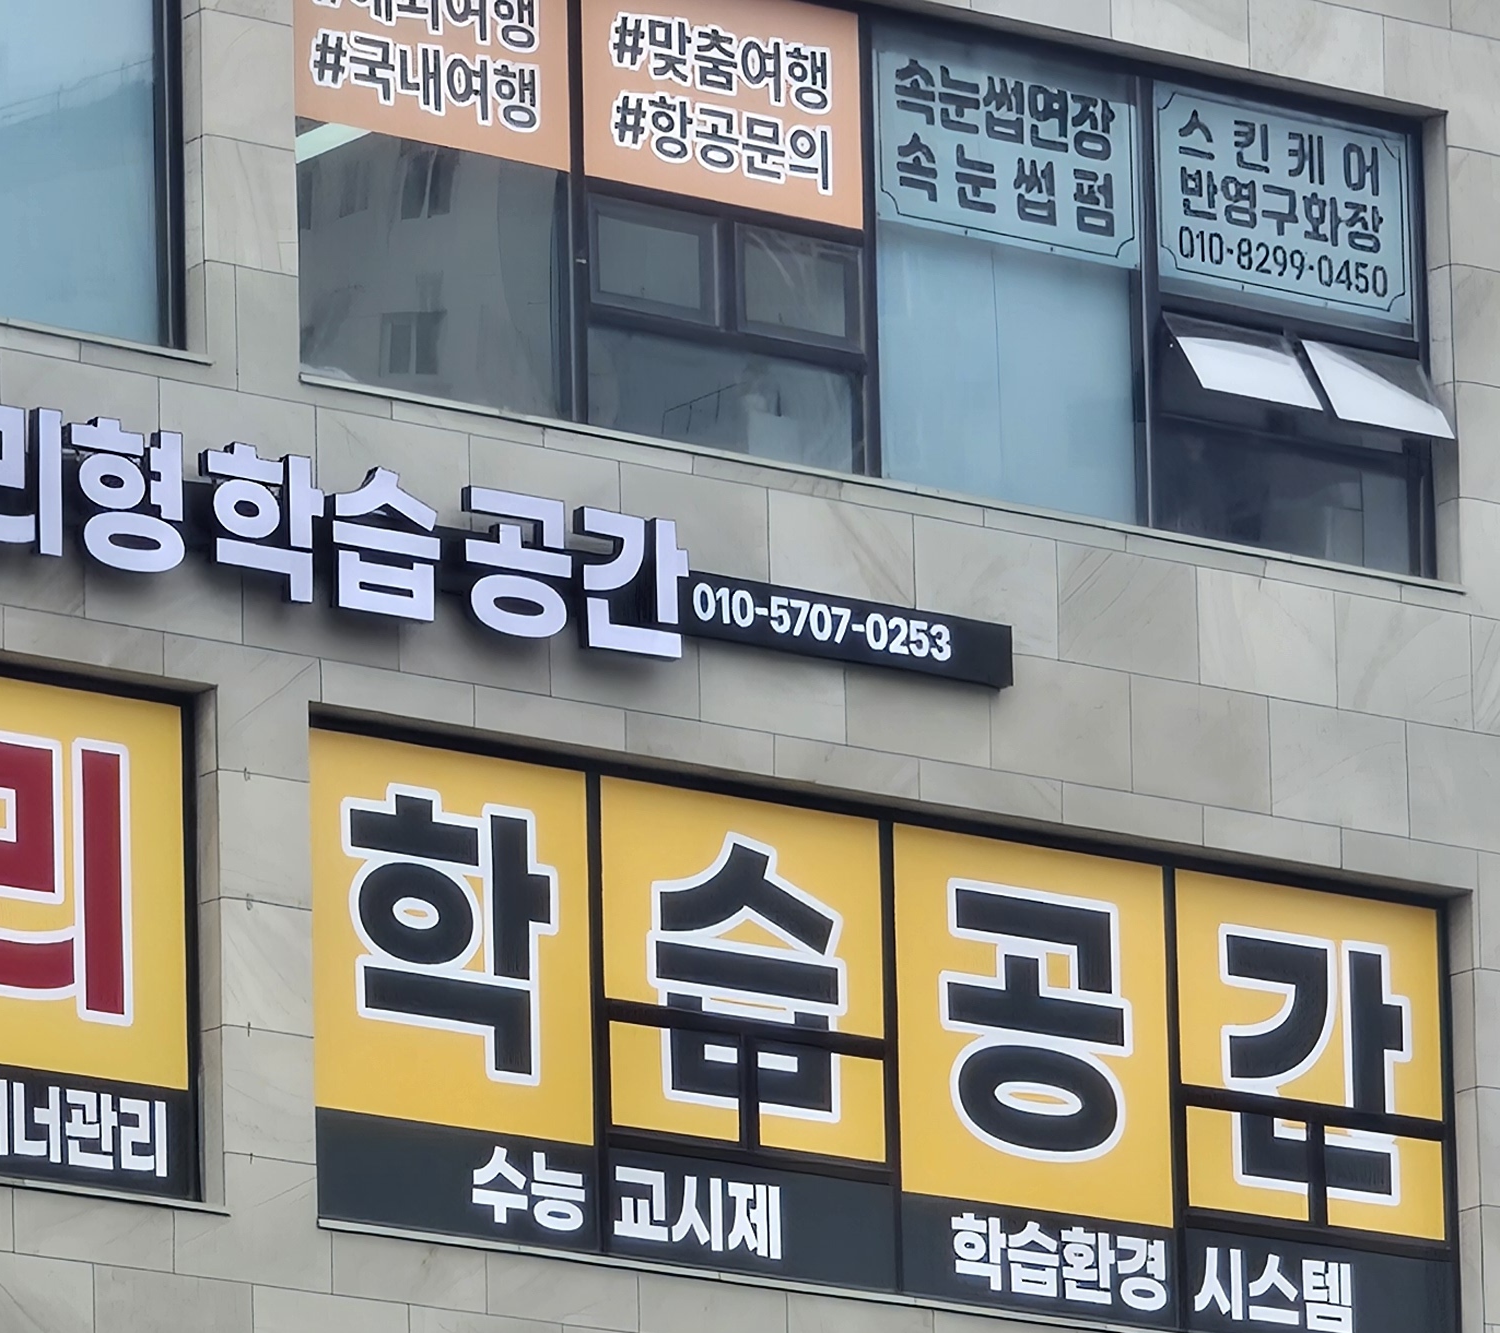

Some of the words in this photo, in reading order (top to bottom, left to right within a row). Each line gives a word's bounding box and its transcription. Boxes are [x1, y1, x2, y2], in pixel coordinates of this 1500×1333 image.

[311, 30, 540, 132] #국내여행
[610, 13, 831, 113] #맞춤여행
[895, 58, 1115, 161] 속눈썹연장
[611, 92, 832, 194] #항공문의
[1180, 166, 1384, 253] 반영구화장
[692, 582, 952, 662] 010-5707-0253
[340, 782, 1413, 1206] 학습공간
[472, 1145, 586, 1232] 수능
[613, 1165, 783, 1260] 교시제
[951, 1212, 1168, 1312] 학습환경
